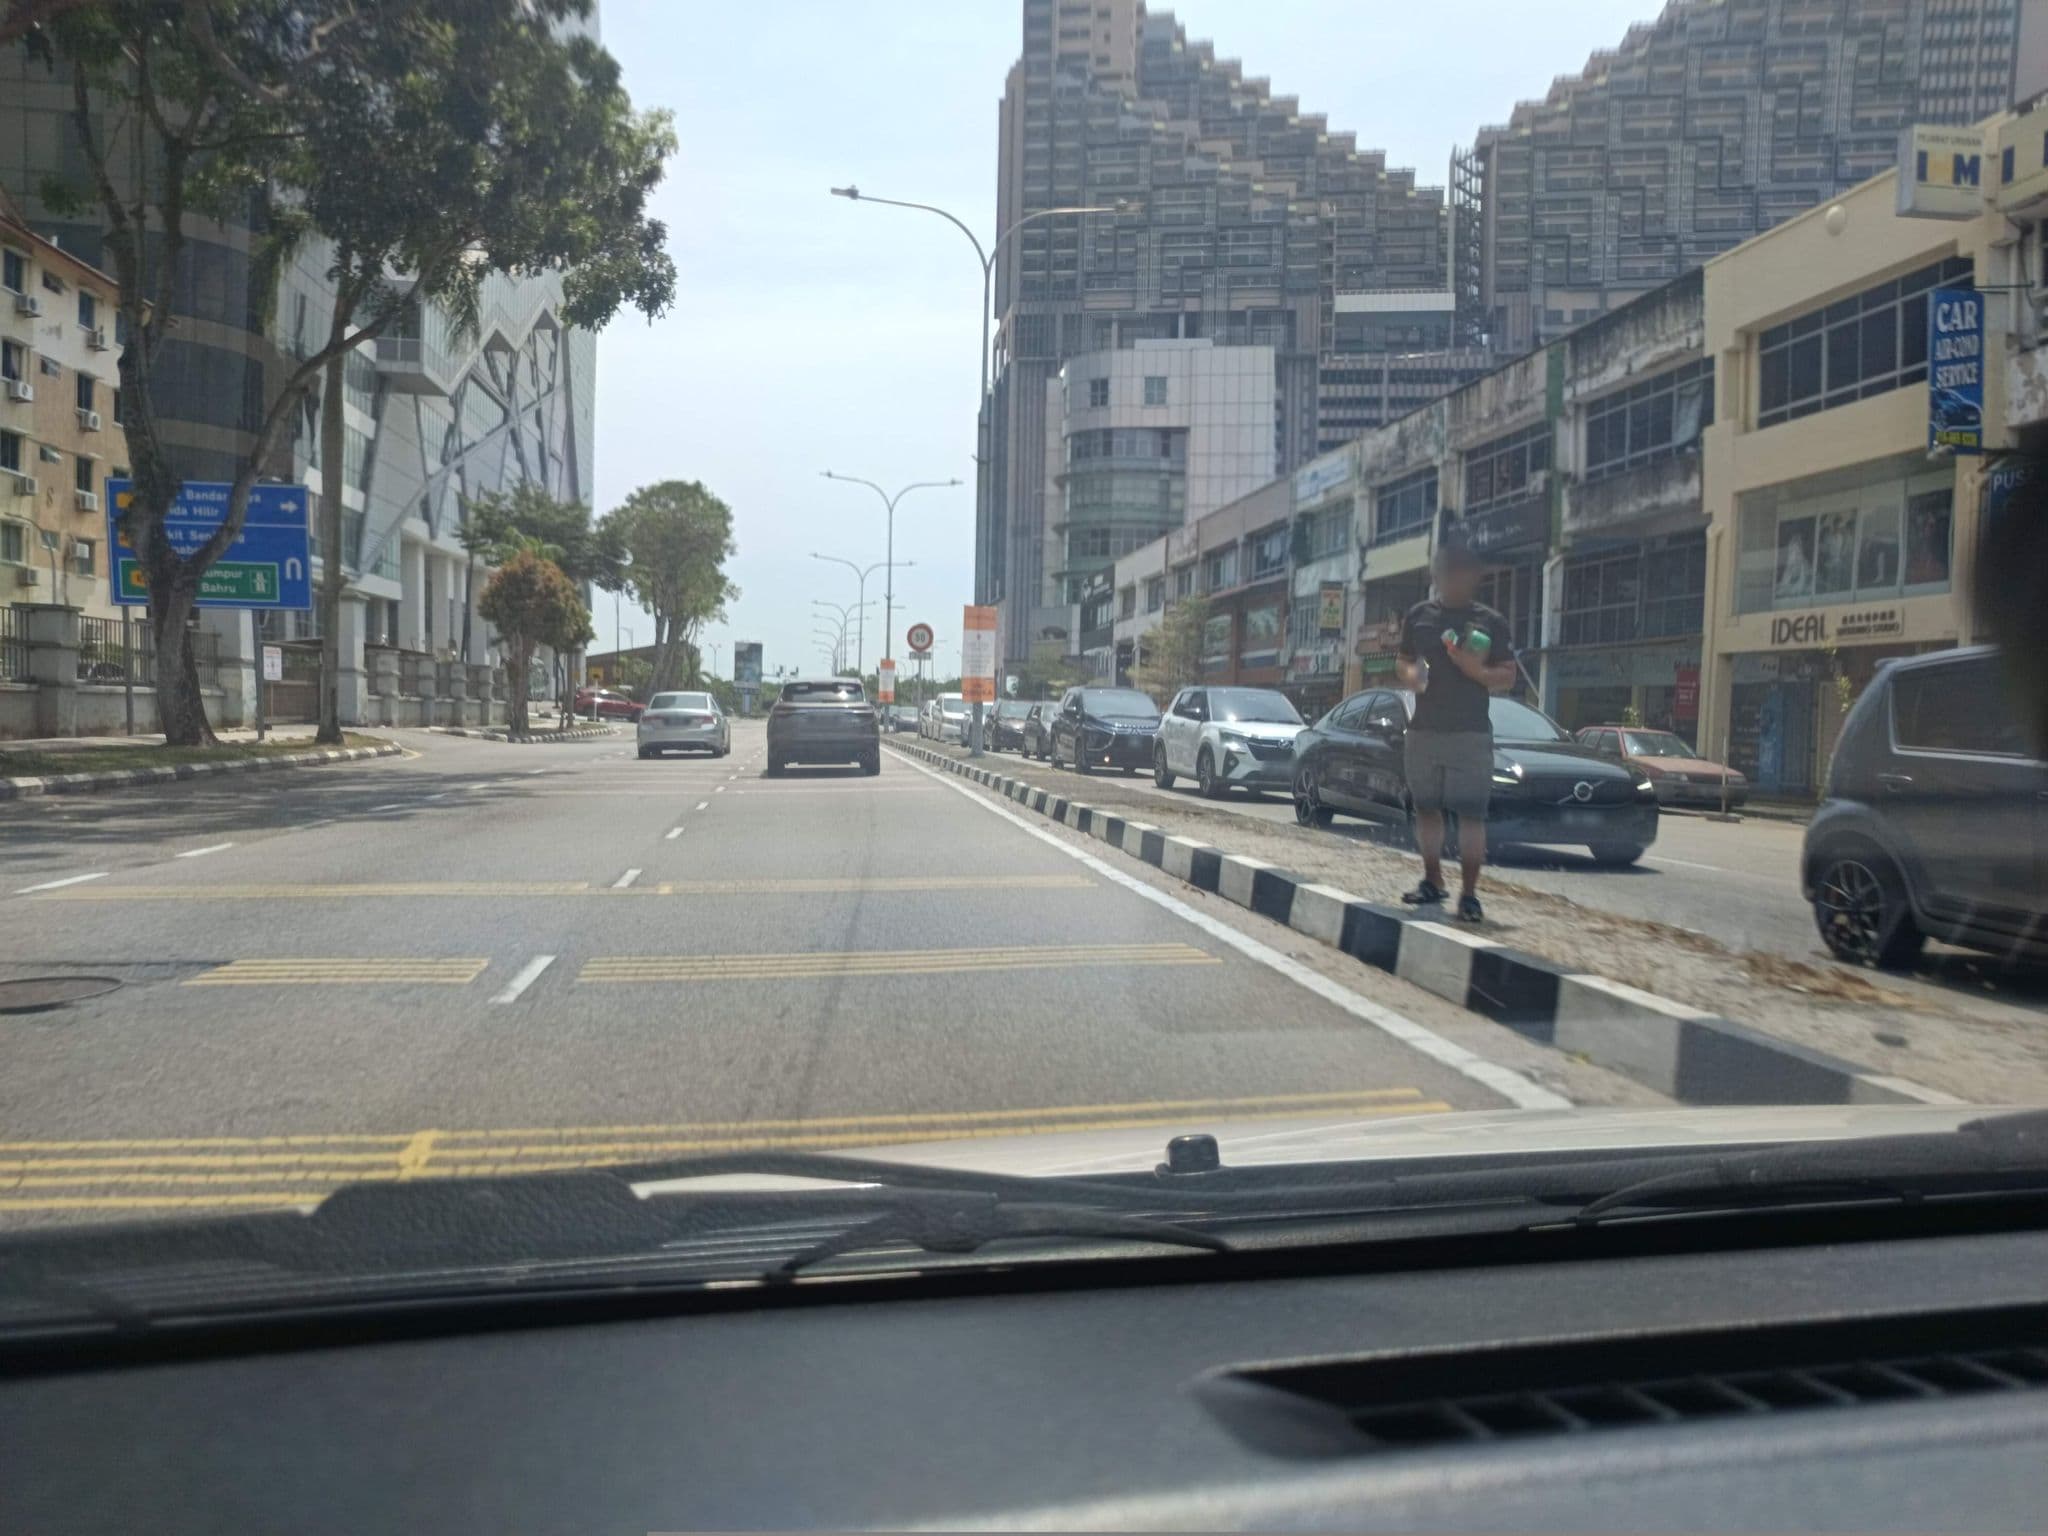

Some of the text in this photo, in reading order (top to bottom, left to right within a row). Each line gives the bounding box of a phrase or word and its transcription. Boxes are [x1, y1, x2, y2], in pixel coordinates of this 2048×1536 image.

[1936, 300, 1978, 332] CAR
[1936, 362, 1978, 388] SERVICE
[186, 489, 228, 500] Bandar
[193, 506, 219, 517] Hilir
[201, 583, 236, 593] Bahru
[1771, 614, 1826, 644] IDEAL
